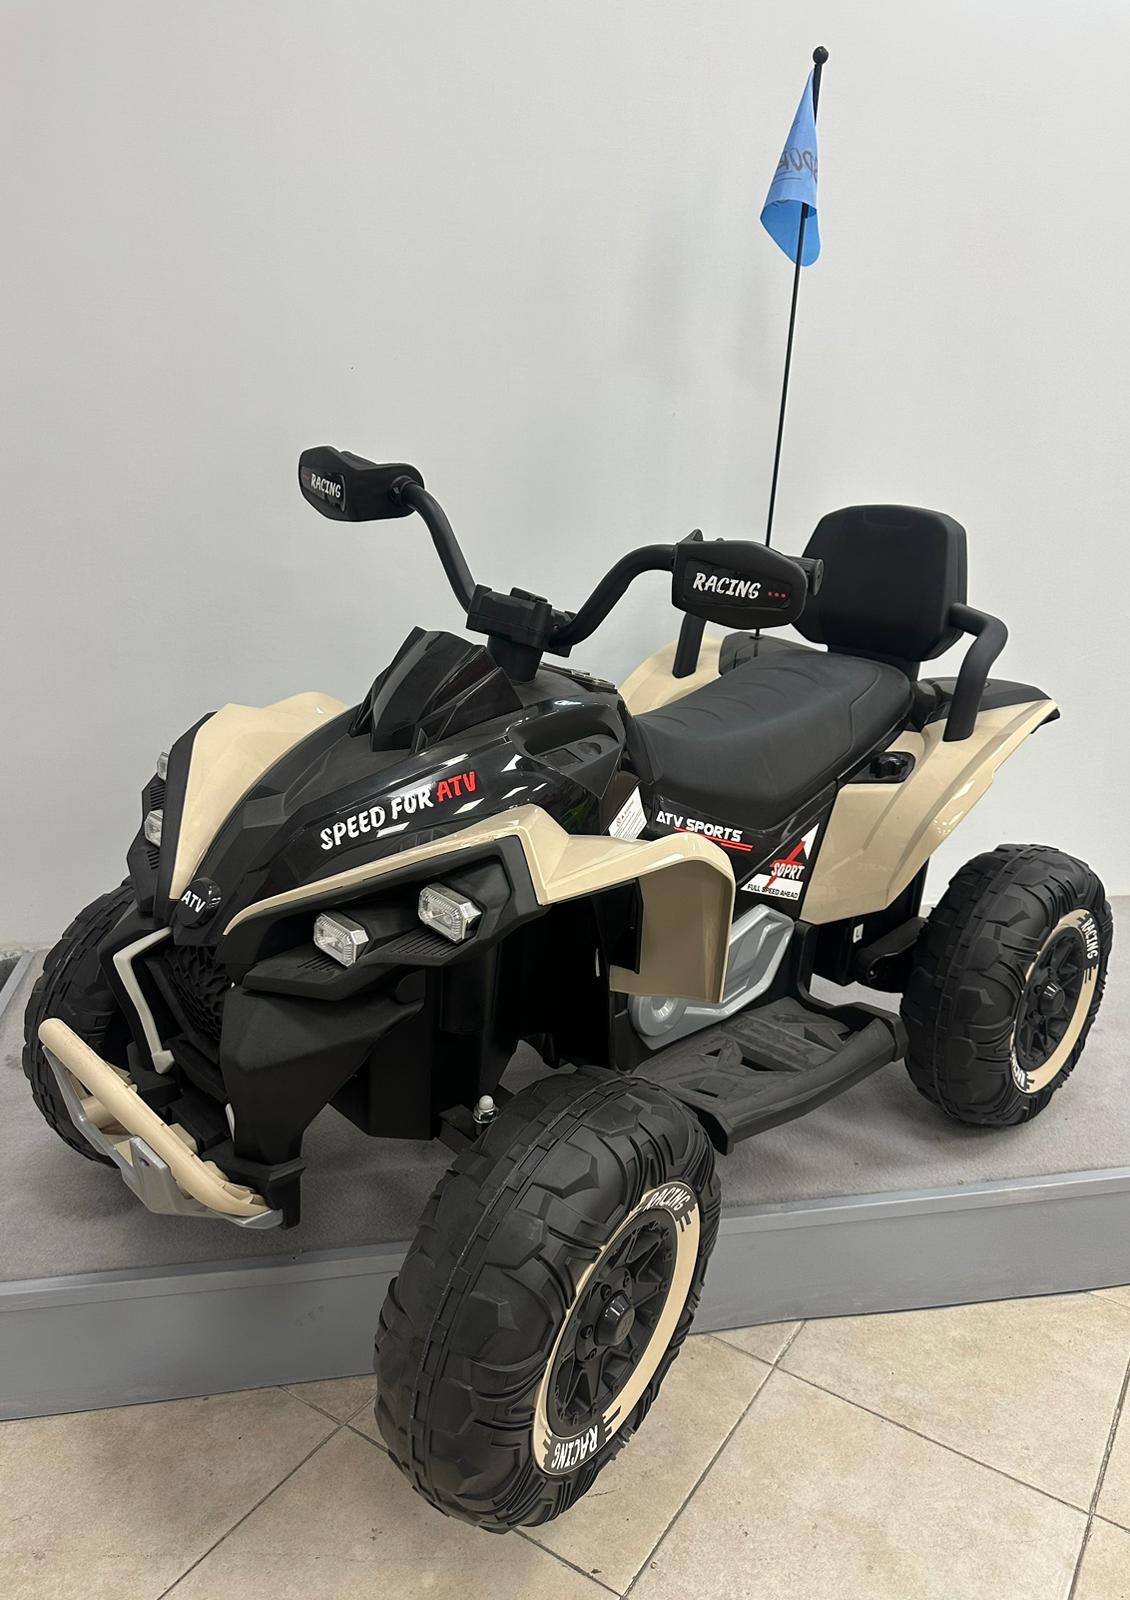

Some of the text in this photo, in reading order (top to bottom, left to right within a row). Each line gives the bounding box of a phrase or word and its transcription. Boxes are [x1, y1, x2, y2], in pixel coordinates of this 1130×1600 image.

[310, 472, 342, 499] RACING
[692, 571, 762, 600] RACING
[319, 770, 477, 851] SPEED FOR ATV
[655, 810, 684, 828] ATV
[686, 818, 743, 843] SPORTS
[770, 861, 806, 881] SOPRT
[180, 889, 207, 913] ATV
[746, 883, 761, 893] FULL
[779, 890, 799, 899] AHEAD
[1080, 917, 1099, 960] RACING
[642, 1186, 691, 1212] RACING
[551, 1424, 598, 1470] RACING
